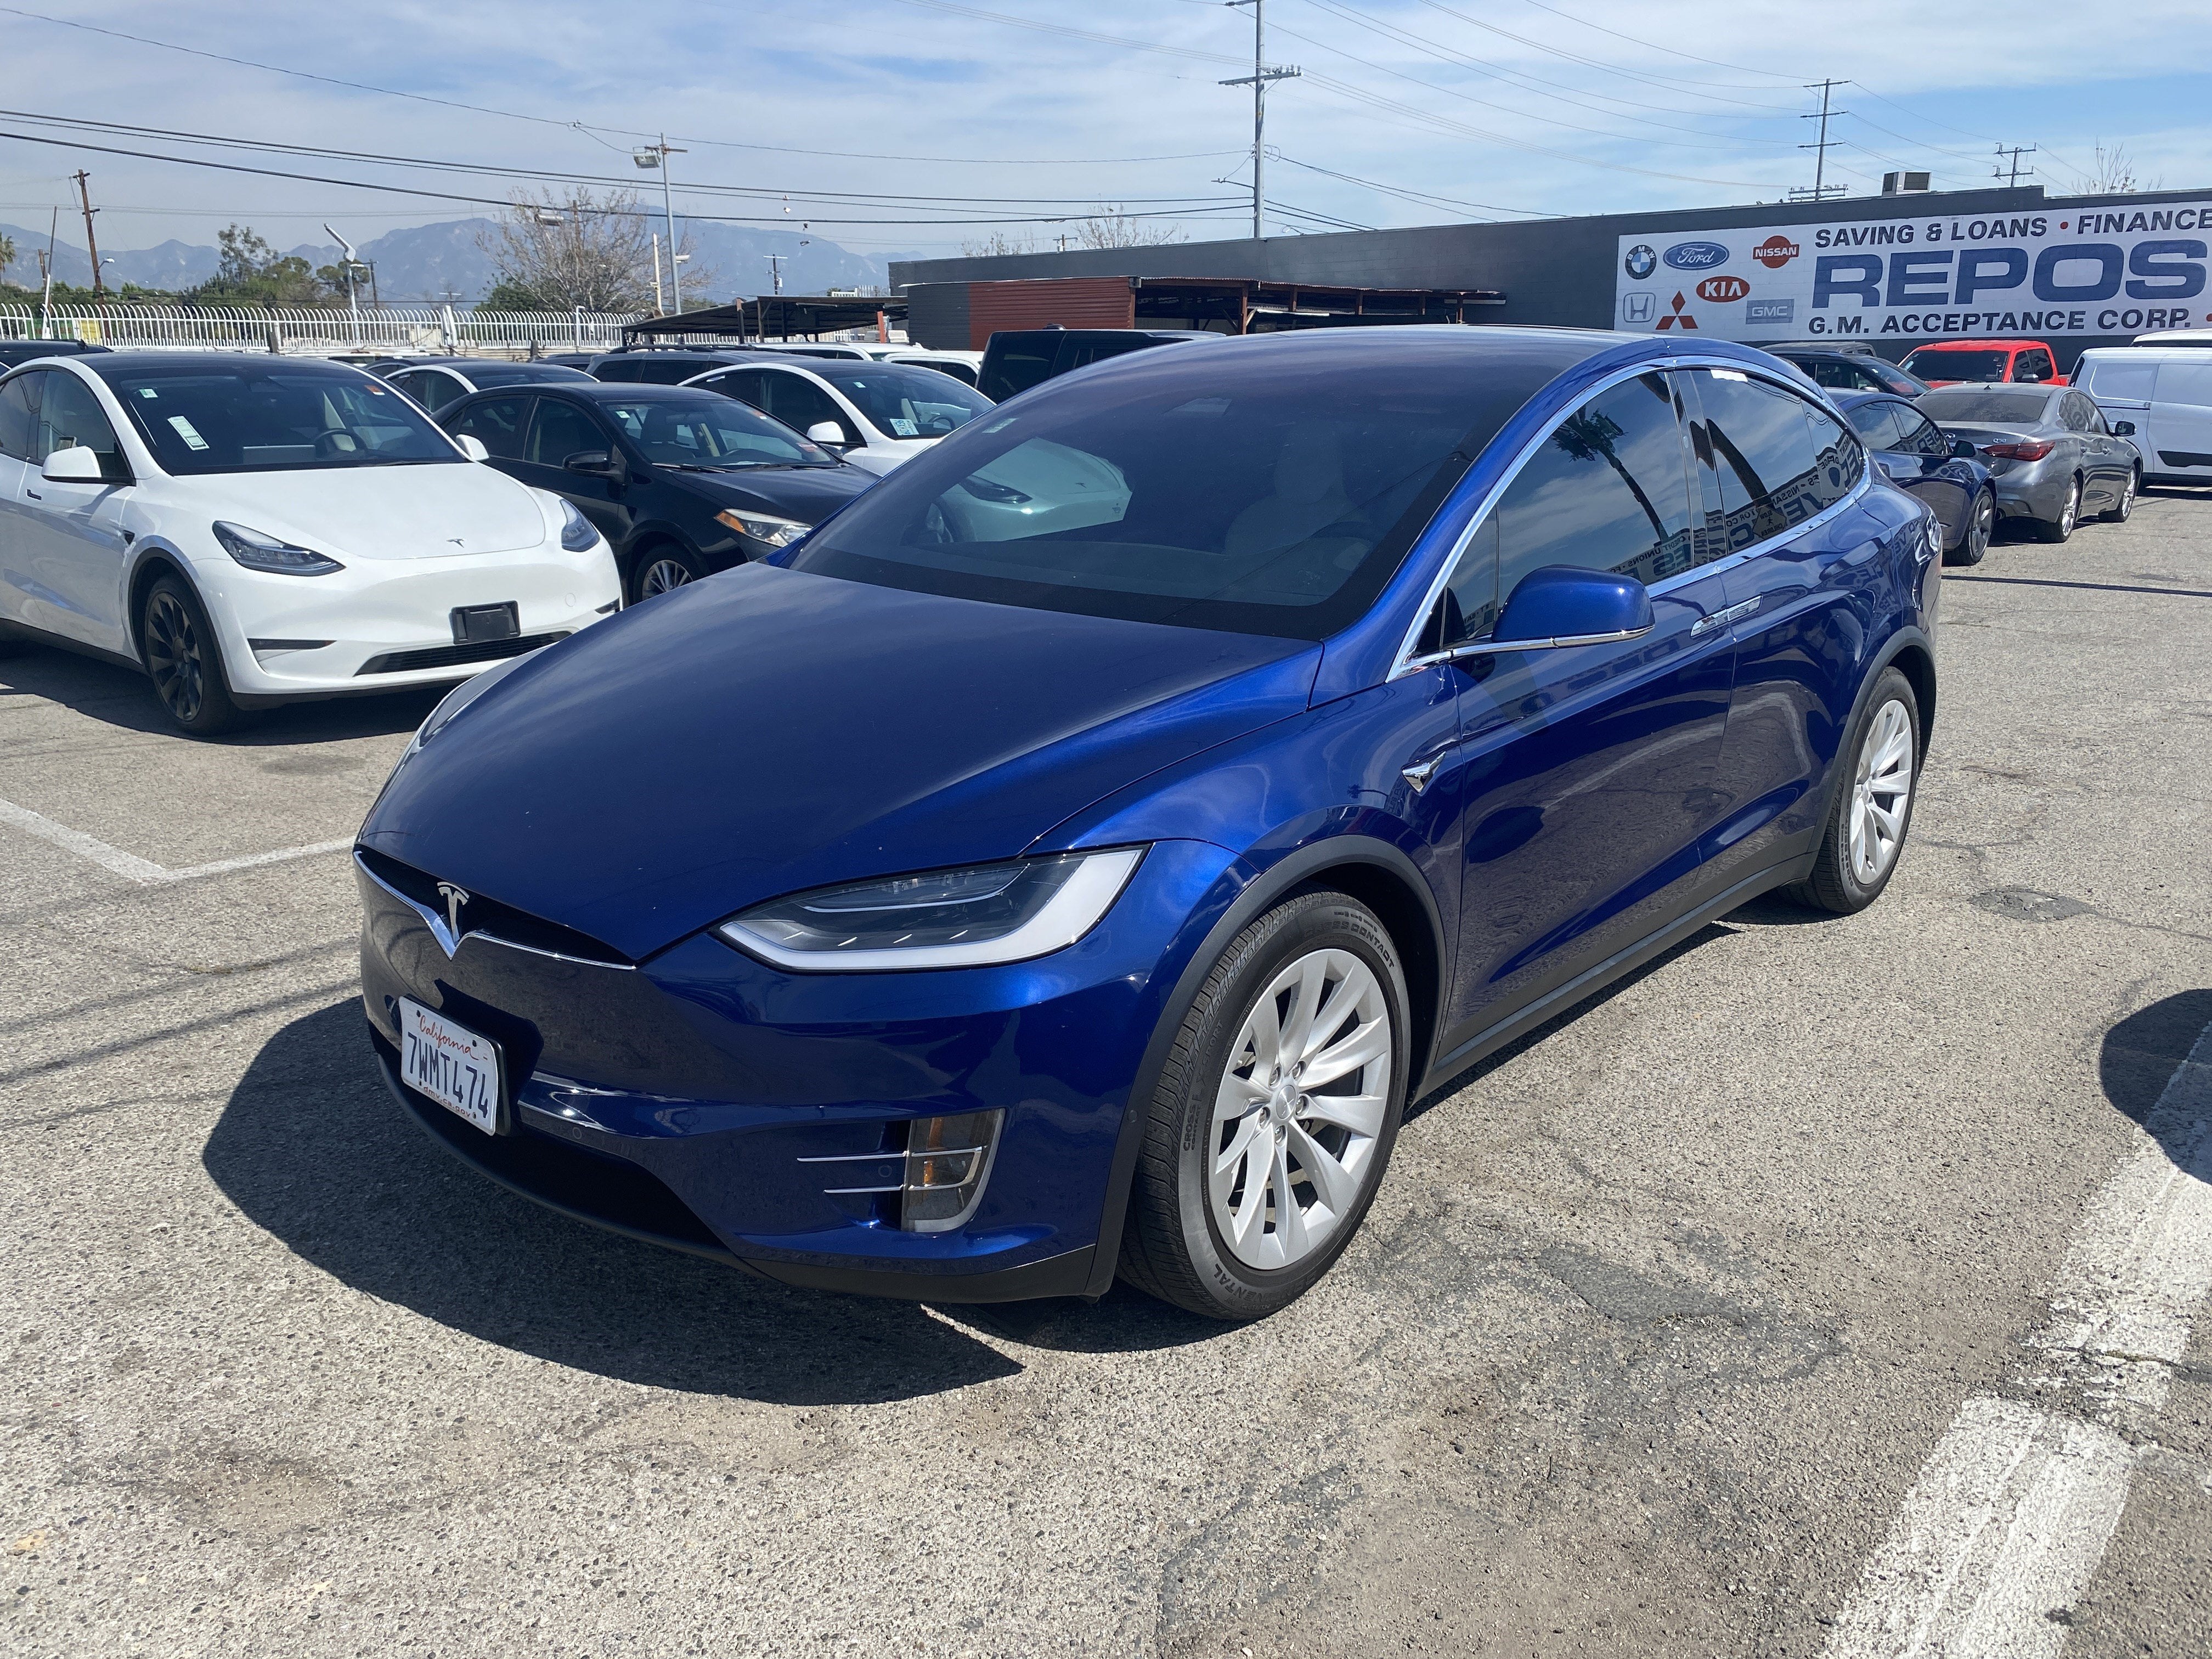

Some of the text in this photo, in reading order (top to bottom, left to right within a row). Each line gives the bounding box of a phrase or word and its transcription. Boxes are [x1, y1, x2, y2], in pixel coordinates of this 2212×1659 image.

[1815, 208, 2212, 248] SAVING & LOANS FINANCE
[1626, 245, 1656, 261] BMW
[1677, 247, 1716, 264] Ford
[1754, 246, 1798, 257] NISSAN
[1812, 239, 2208, 308] REPOS
[1704, 281, 1742, 297] KIA
[1751, 305, 1788, 317] GMC
[1809, 308, 2191, 334] G.M. ACCEPTANCE CORP.
[420, 1014, 479, 1060] California
[408, 1031, 488, 1119] 7WMT474
[423, 1086, 471, 1118] dmv.ca.gov
